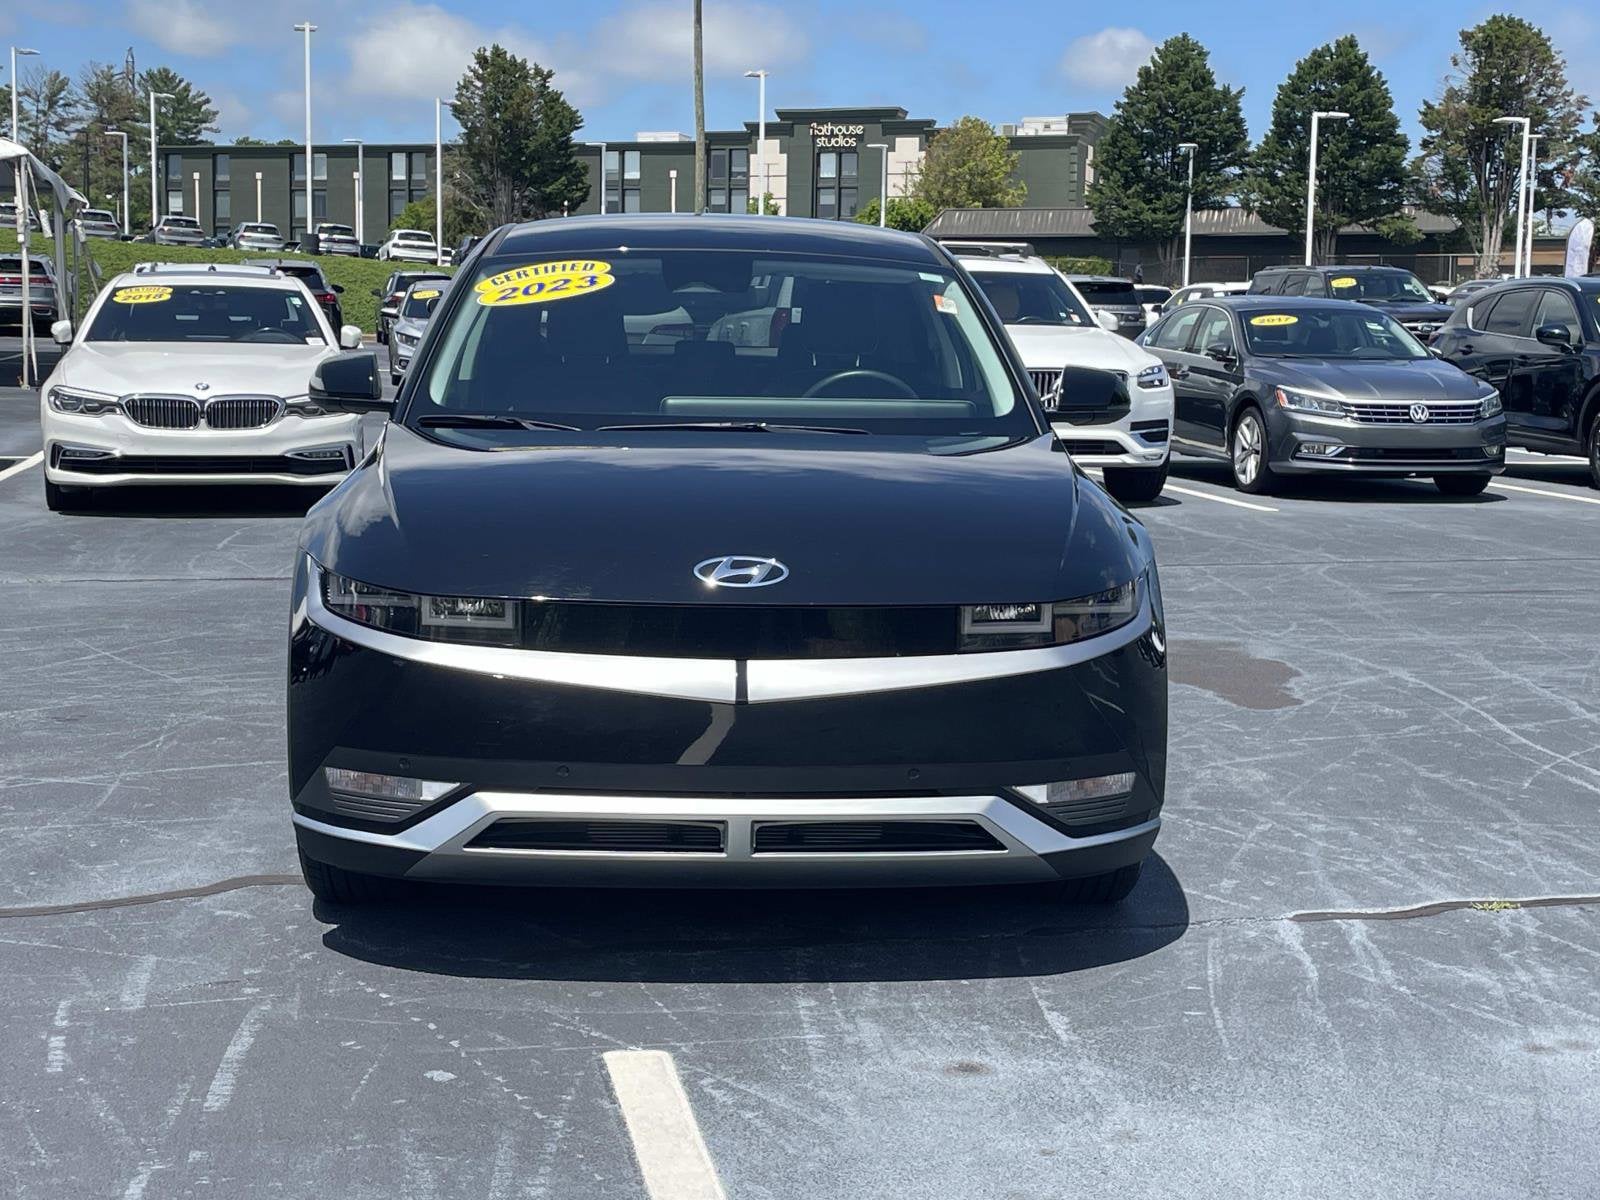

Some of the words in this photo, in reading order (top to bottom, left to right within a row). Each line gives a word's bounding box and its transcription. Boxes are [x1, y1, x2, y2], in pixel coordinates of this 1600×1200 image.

[816, 134, 857, 147] studios
[491, 262, 596, 286] CERTIFIED
[121, 293, 164, 302] 2018
[495, 275, 599, 302] 2023
